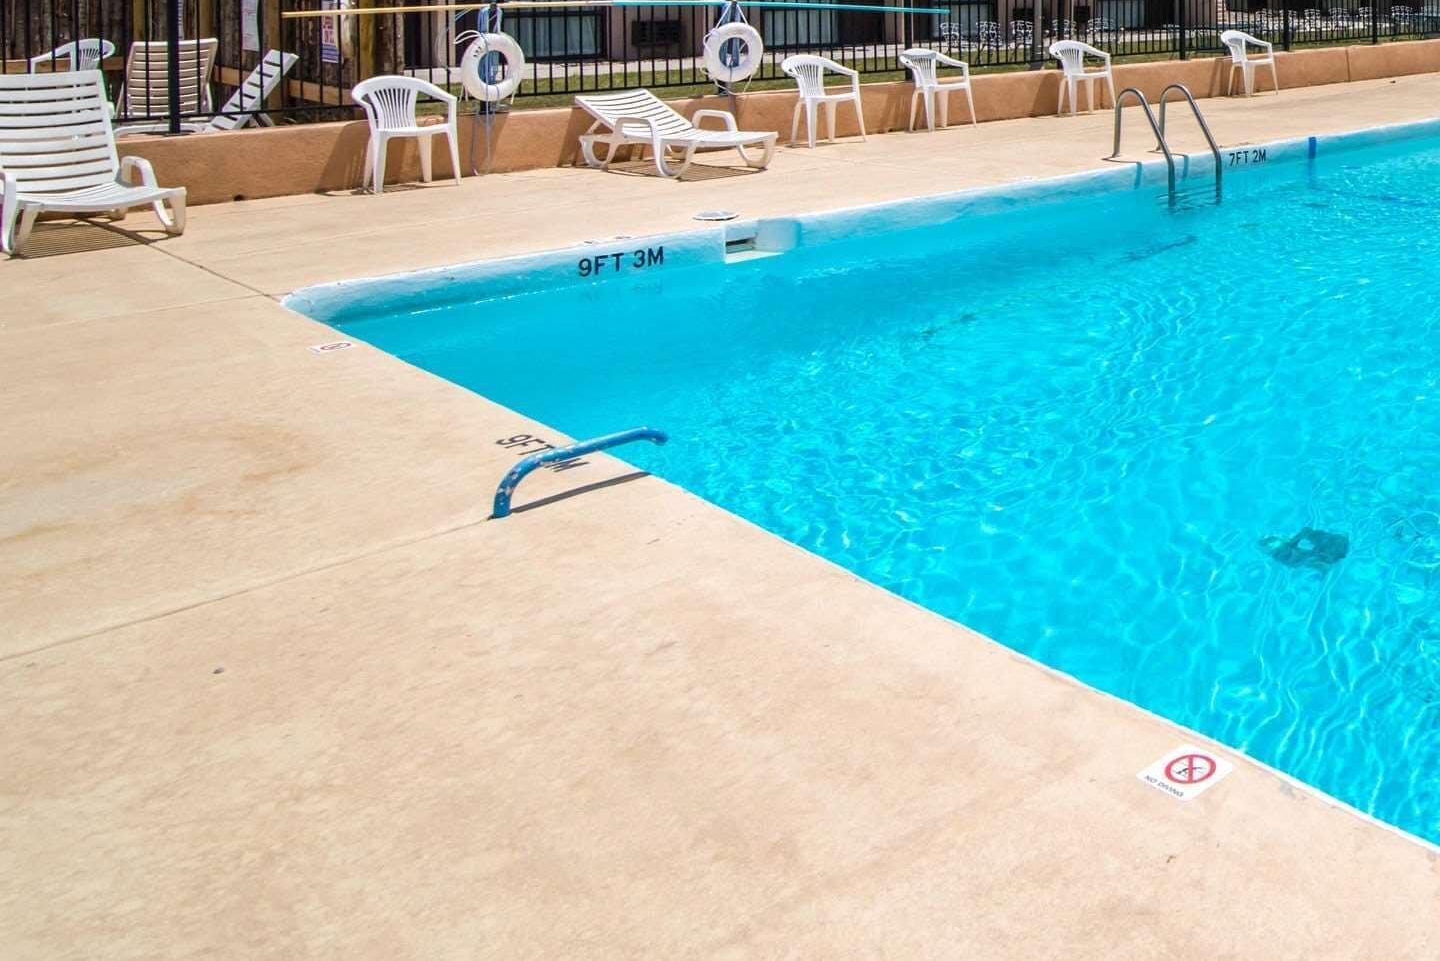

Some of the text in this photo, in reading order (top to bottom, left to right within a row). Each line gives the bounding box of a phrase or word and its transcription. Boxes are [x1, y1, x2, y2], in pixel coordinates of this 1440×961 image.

[1228, 149, 1267, 167] 7FT 2M
[578, 246, 664, 277] 9FT 3M
[495, 433, 557, 456] 9FT
